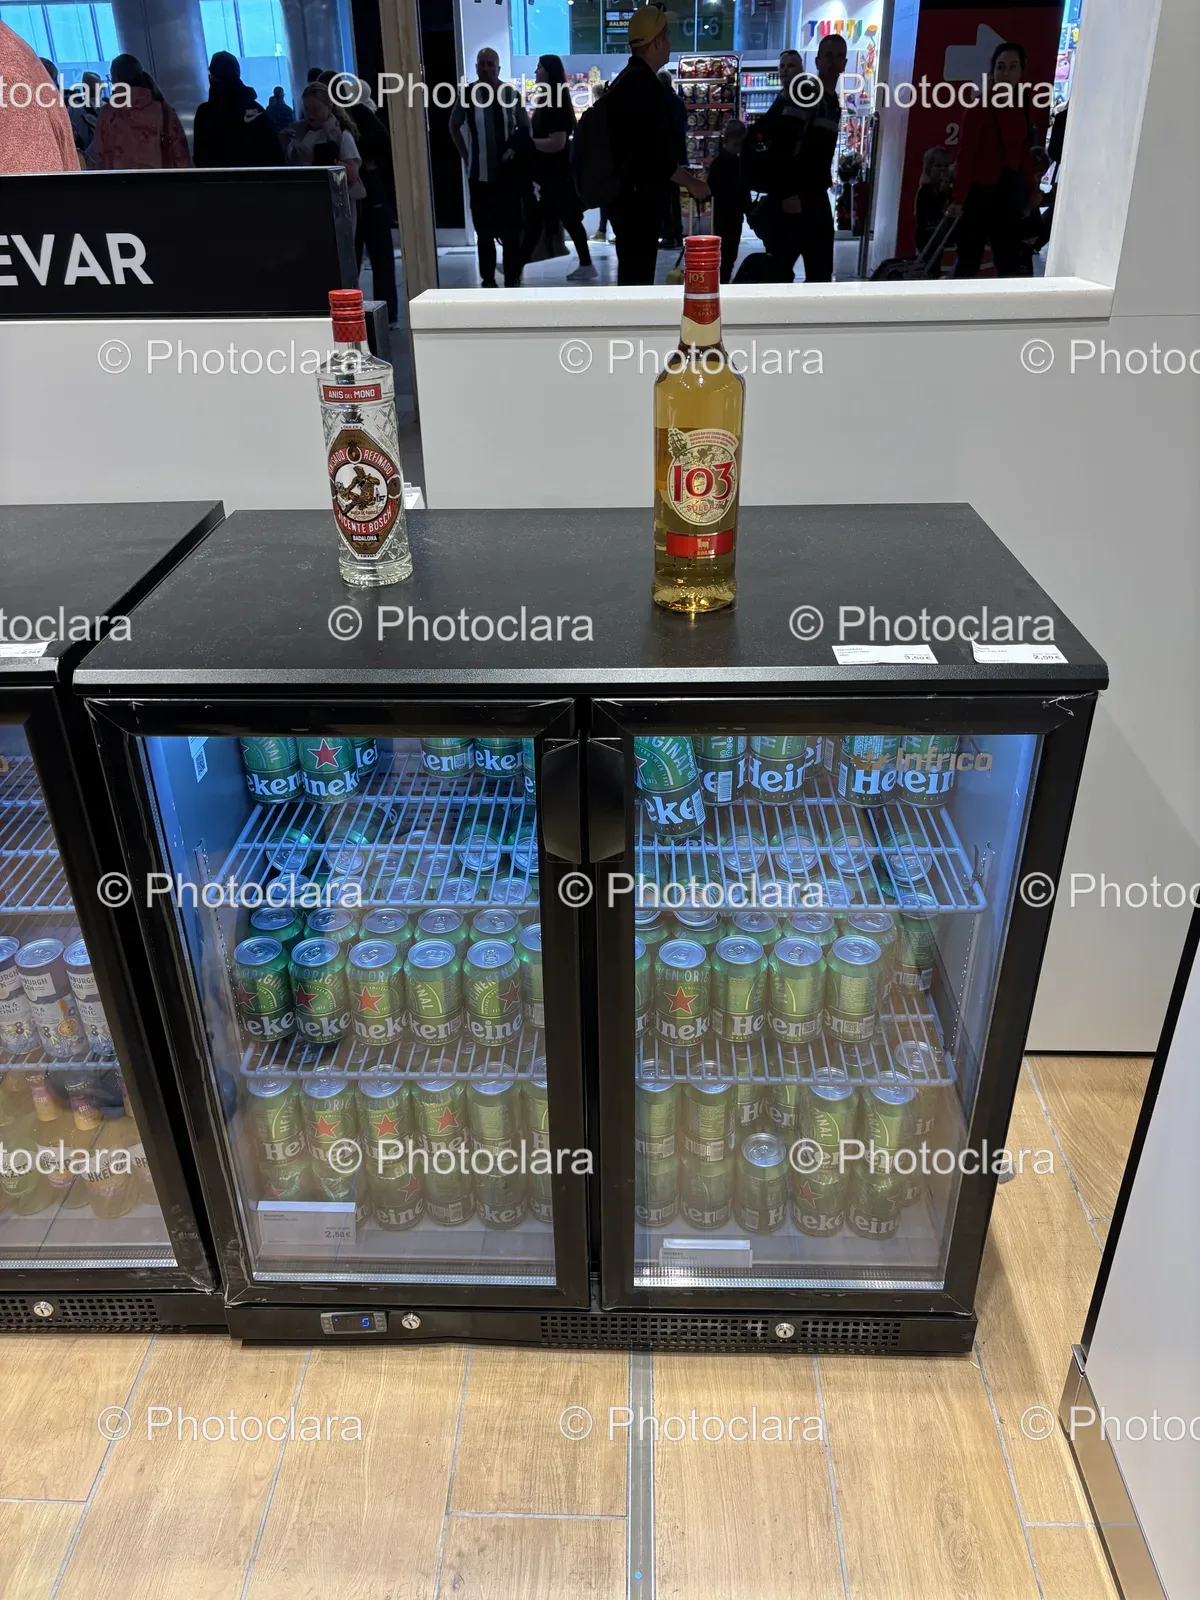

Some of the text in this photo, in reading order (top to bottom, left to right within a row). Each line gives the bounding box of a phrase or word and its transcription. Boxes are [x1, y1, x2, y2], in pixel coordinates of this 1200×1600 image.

[682, 17, 720, 37] C16
[688, 272, 705, 284] 103
[328, 390, 344, 398] ANIS
[353, 389, 375, 399] MONO
[364, 449, 393, 475] REFINADO
[673, 461, 734, 502] 103
[368, 505, 392, 533] BOSCH
